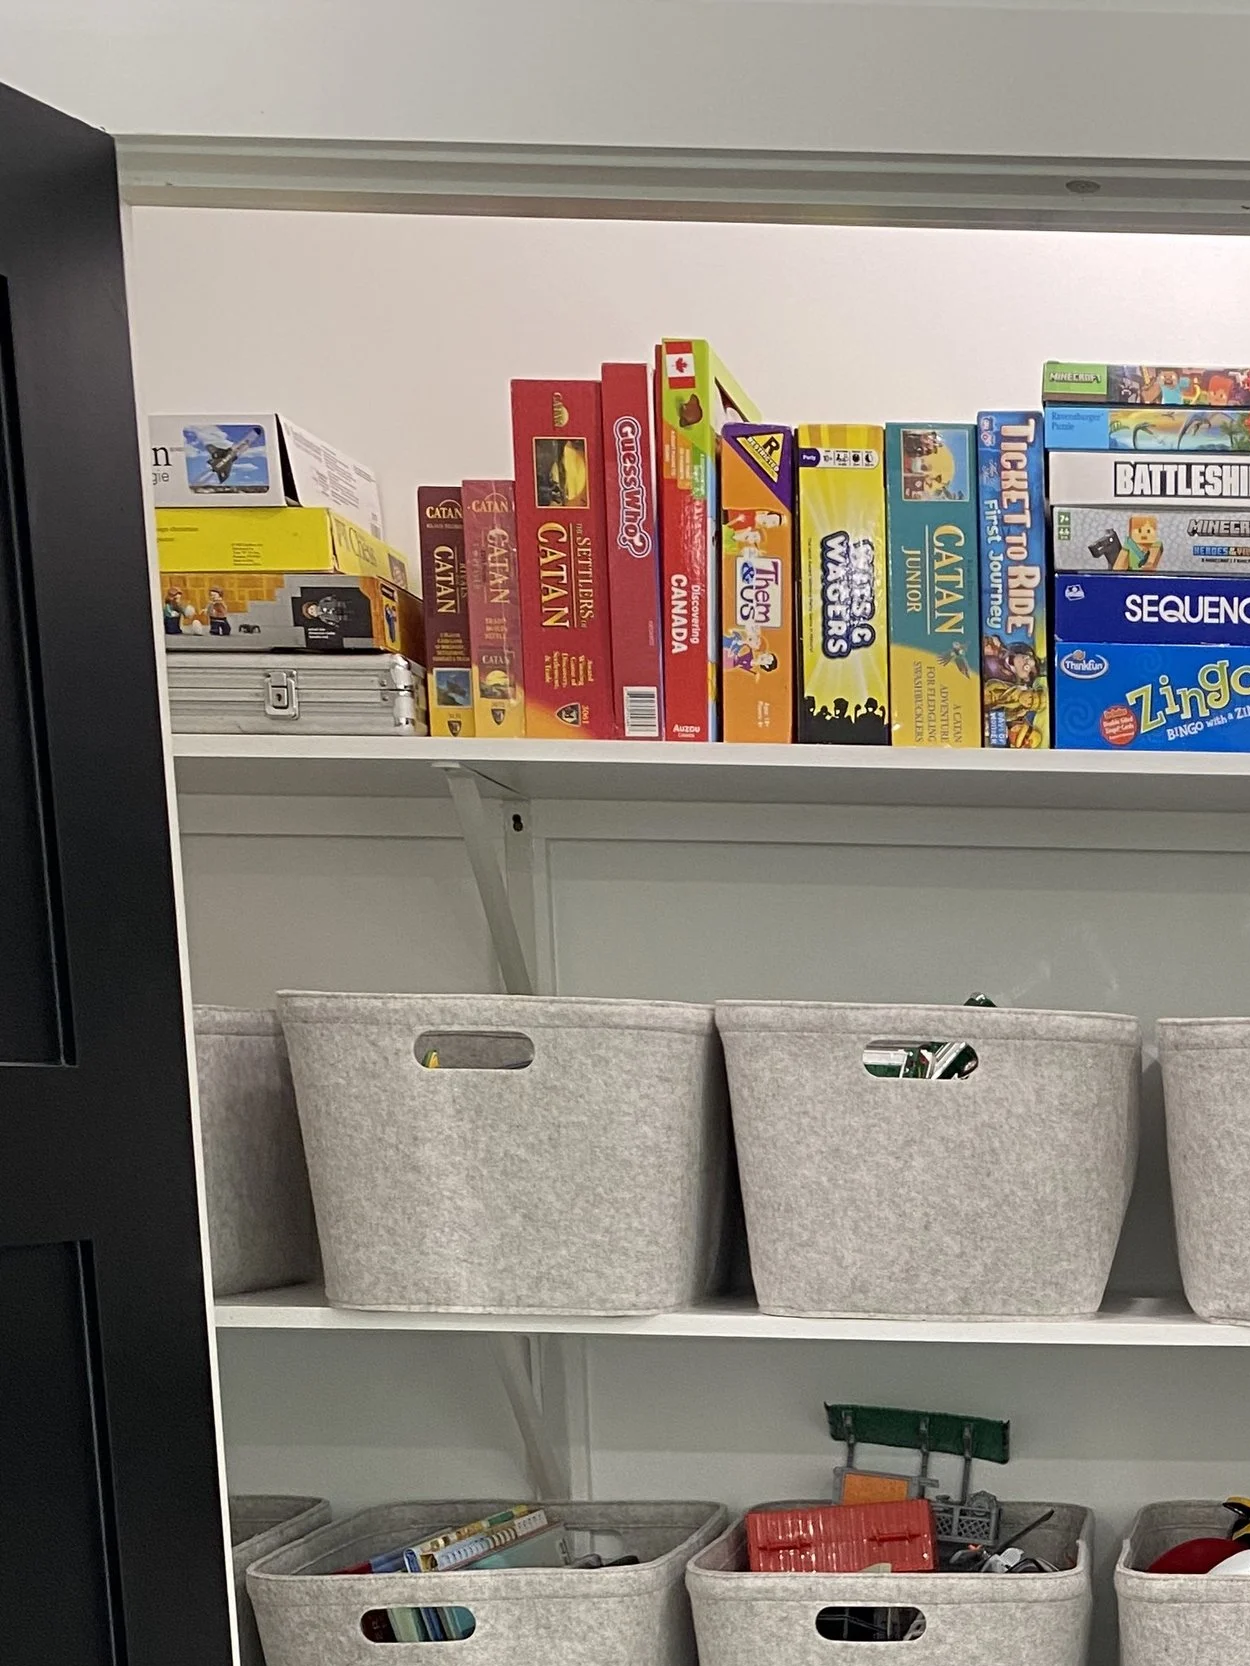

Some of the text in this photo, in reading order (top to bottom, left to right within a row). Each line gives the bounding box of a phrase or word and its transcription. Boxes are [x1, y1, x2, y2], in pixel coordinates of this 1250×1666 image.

[1049, 372, 1101, 384] MINECRAFT
[747, 436, 780, 472] RESTRICTED
[762, 436, 780, 456] R
[425, 505, 463, 519] CATAN
[471, 500, 509, 513] CATAN
[984, 499, 1001, 543] First
[1000, 418, 1041, 638] TICKET TO RIDE
[433, 545, 456, 614] CATAN
[487, 528, 510, 604] CATAN
[537, 522, 570, 629] CATAN
[576, 536, 595, 620] SETTLERS
[741, 561, 755, 584] &
[755, 560, 779, 623] Them
[822, 532, 851, 657] WAGERS
[901, 545, 923, 614] JUNIOR
[933, 523, 965, 635] CATAN
[986, 550, 1003, 629] Journey
[671, 573, 689, 654] CANADA
[689, 584, 702, 645] Discovering
[913, 660, 924, 743] SWASHBUCKLERS
[926, 666, 936, 686] FOR
[940, 684, 950, 743] ADVENTURE
[953, 712, 963, 743] CATAN
[1166, 720, 1204, 741] BINGO
[1206, 714, 1228, 728] with
[1227, 712, 1234, 721] a
